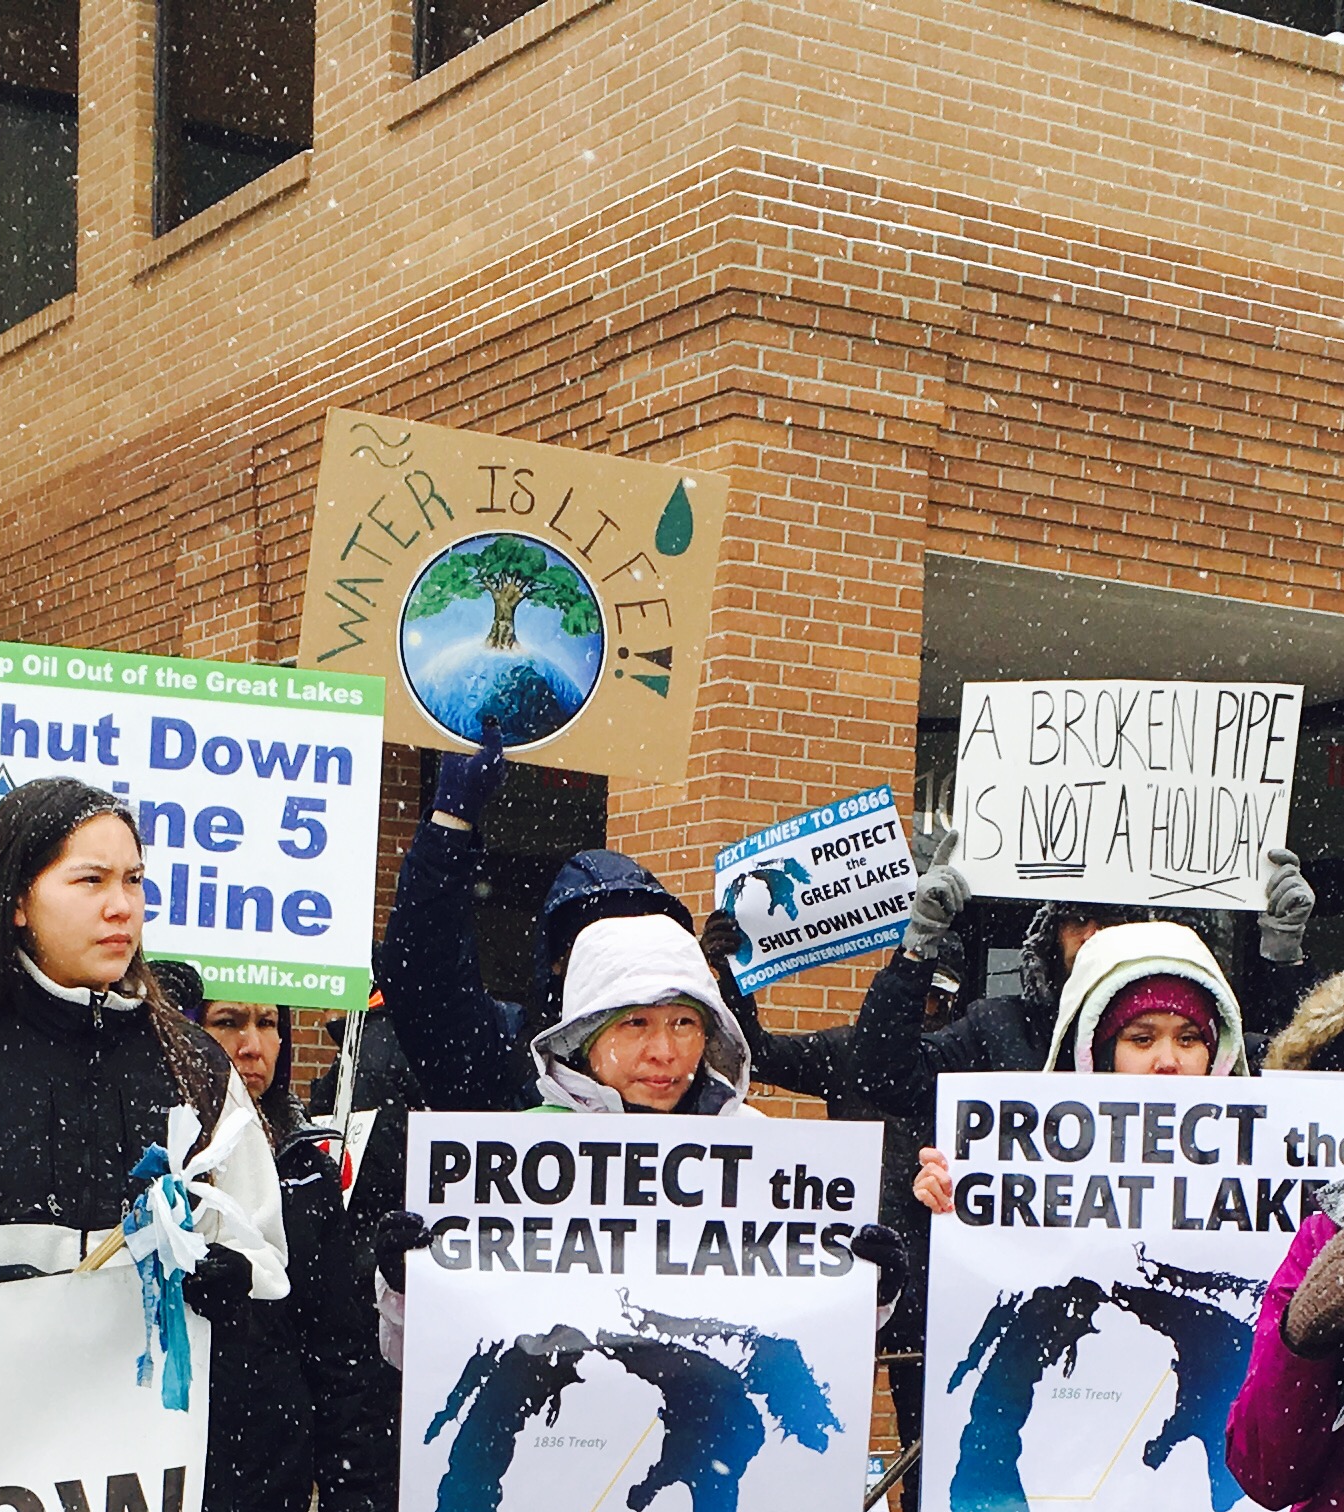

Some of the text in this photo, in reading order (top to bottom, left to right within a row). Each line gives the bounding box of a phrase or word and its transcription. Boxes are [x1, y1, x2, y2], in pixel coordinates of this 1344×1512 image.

[316, 469, 454, 663] WATER
[476, 466, 535, 515] IS
[22, 655, 57, 677] Oil
[67, 659, 113, 682] Out
[122, 665, 148, 685] of
[155, 667, 197, 689] the
[206, 671, 278, 697] Great
[287, 678, 363, 705] Lakes
[149, 717, 353, 786] Down
[961, 687, 1294, 784] A BROKEN PIPE
[278, 796, 327, 860] 5
[717, 842, 748, 869] TEXT
[811, 808, 834, 829] TO
[838, 787, 890, 819] 69866
[810, 820, 896, 866] PROTECT
[963, 785, 1003, 861] IS
[1019, 781, 1106, 862] NOT
[1106, 783, 1133, 872] A
[800, 858, 912, 906] GREAT LAKES
[846, 855, 867, 870] the
[758, 894, 909, 954] SHUT DOWN LINE
[739, 928, 900, 989] FOODANDWATERWATCH.ORG
[955, 1100, 1267, 1165] PROTECT
[429, 1141, 855, 1212] PROTECT the
[956, 1173, 1330, 1233] GREAT LAKE
[428, 1217, 855, 1278] GREAT LAKES
[1052, 1388, 1122, 1402] 1836 Treaty
[534, 1437, 607, 1450] 1836 Treaty
